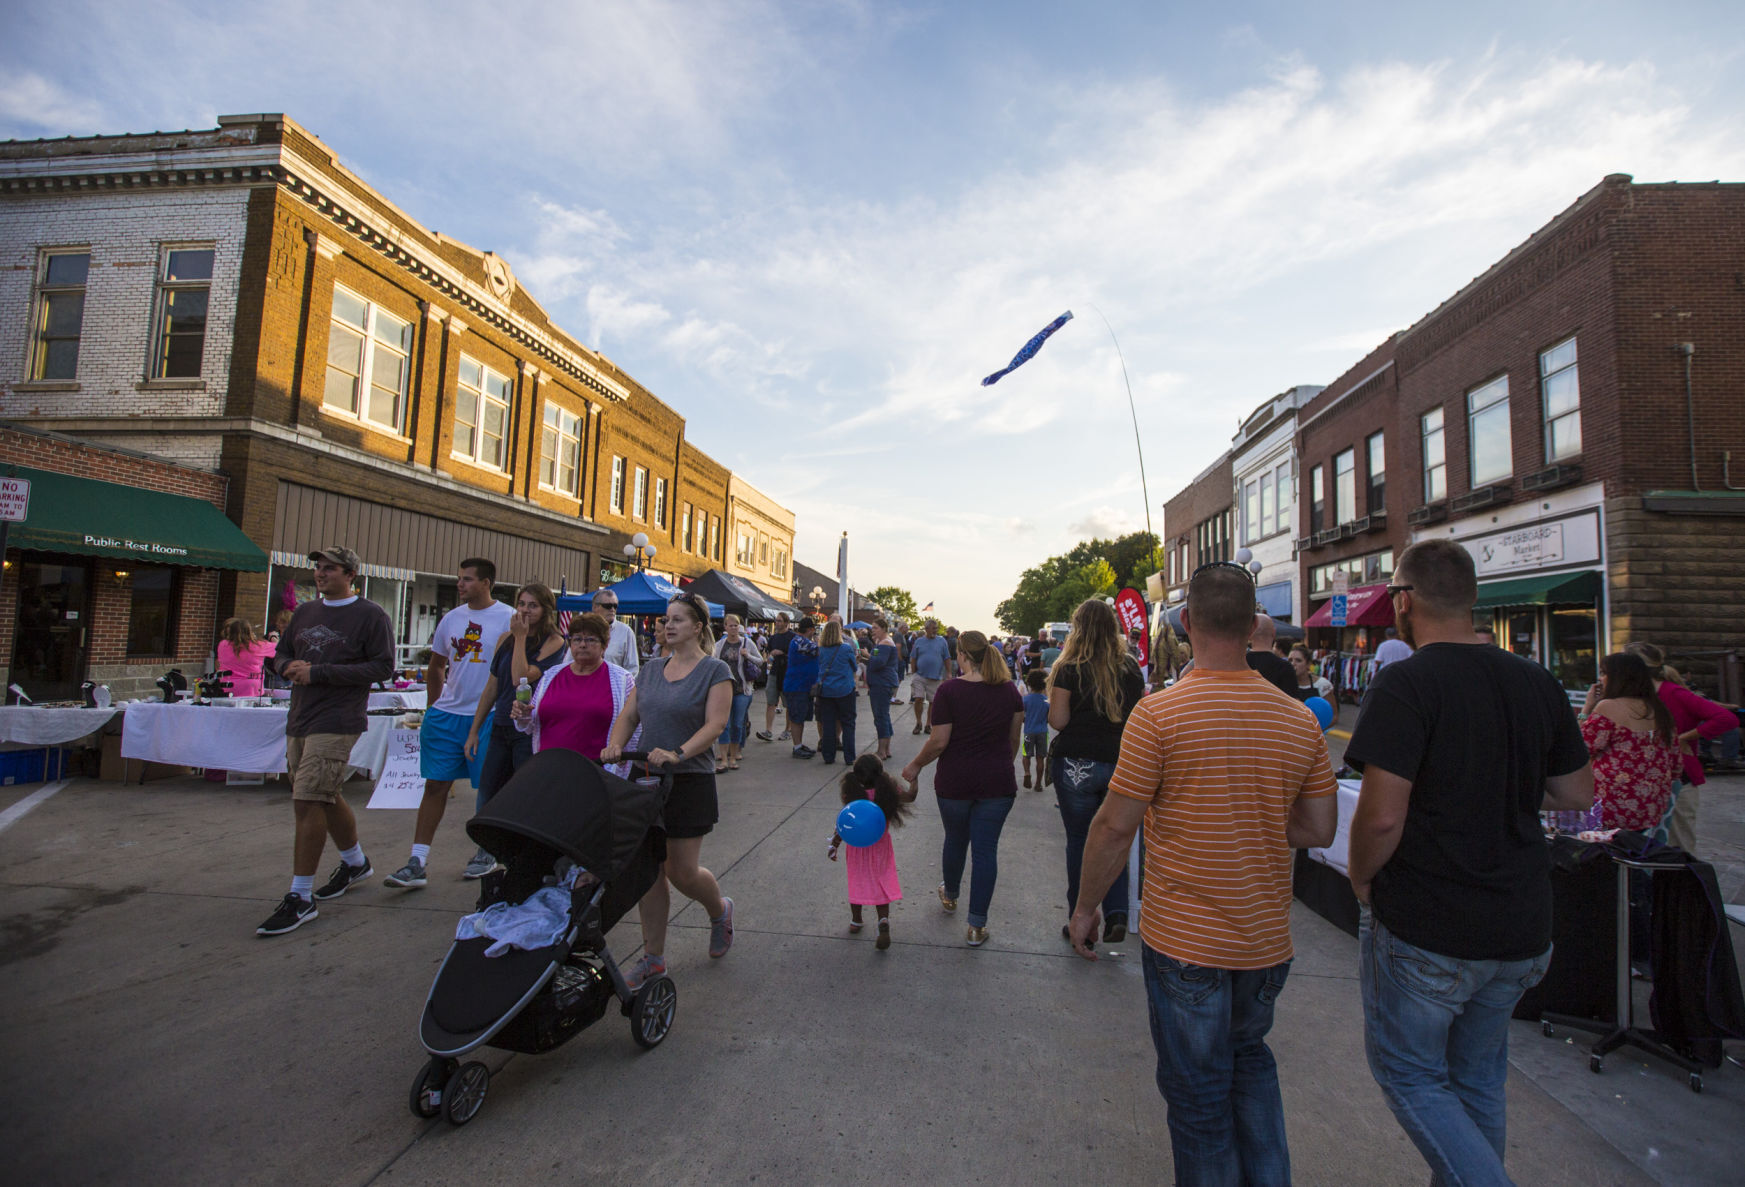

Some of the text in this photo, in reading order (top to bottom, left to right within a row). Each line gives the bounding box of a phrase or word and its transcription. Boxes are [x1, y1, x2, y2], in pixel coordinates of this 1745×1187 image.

[2, 482, 18, 492] NO
[84, 535, 188, 556] Public Rest Rooms
